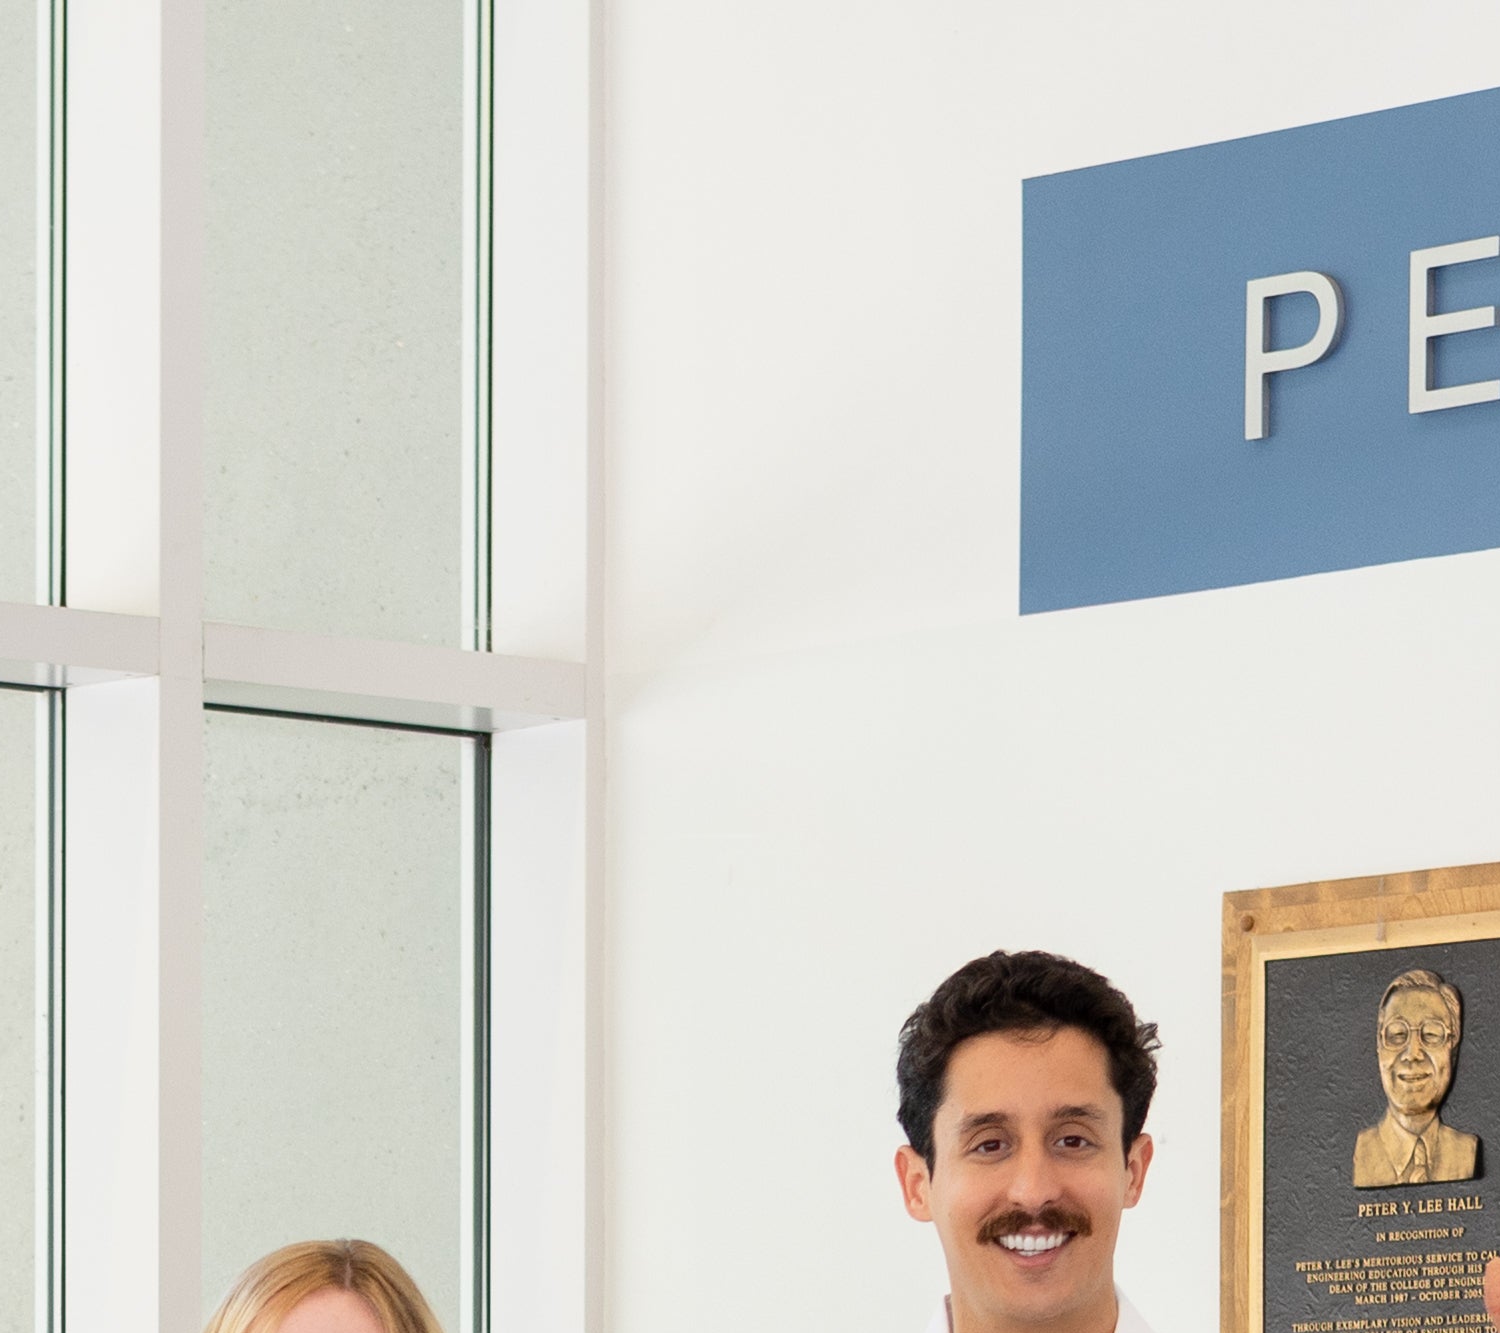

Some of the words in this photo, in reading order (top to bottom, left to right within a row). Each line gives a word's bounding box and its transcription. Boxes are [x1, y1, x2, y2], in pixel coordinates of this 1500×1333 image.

[1358, 1201, 1397, 1217] PETER
[1402, 1201, 1414, 1214] Y.
[1418, 1199, 1442, 1213] LEE
[1447, 1195, 1482, 1211] HALL
[1376, 1232, 1385, 1242] IN
[1388, 1228, 1449, 1241] RECOGNITION
[1451, 1227, 1464, 1237] OF
[1295, 1260, 1321, 1271] PETER
[1335, 1258, 1360, 1269] LEE'S
[1363, 1254, 1422, 1267] MERITORIOUS
[1425, 1252, 1462, 1263] SERVICE
[1465, 1251, 1478, 1261] TO
[1306, 1270, 1365, 1283] ENGINEERING
[1368, 1267, 1418, 1279] EDUCATION
[1421, 1264, 1464, 1276] THROUGH
[1467, 1263, 1482, 1273] HIS
[1329, 1284, 1352, 1294] DEAN
[1355, 1283, 1367, 1292] OF
[1370, 1281, 1387, 1291] THE
[1390, 1279, 1430, 1290] COLLEGE
[1433, 1278, 1445, 1288] OF
[1355, 1293, 1386, 1304] MARCH
[1419, 1289, 1460, 1301] OCTOBER
[1291, 1321, 1332, 1333] THROUGH
[1336, 1318, 1387, 1330] EXEMPLARY
[1391, 1317, 1421, 1327] VISION
[1423, 1315, 1443, 1326] AND
